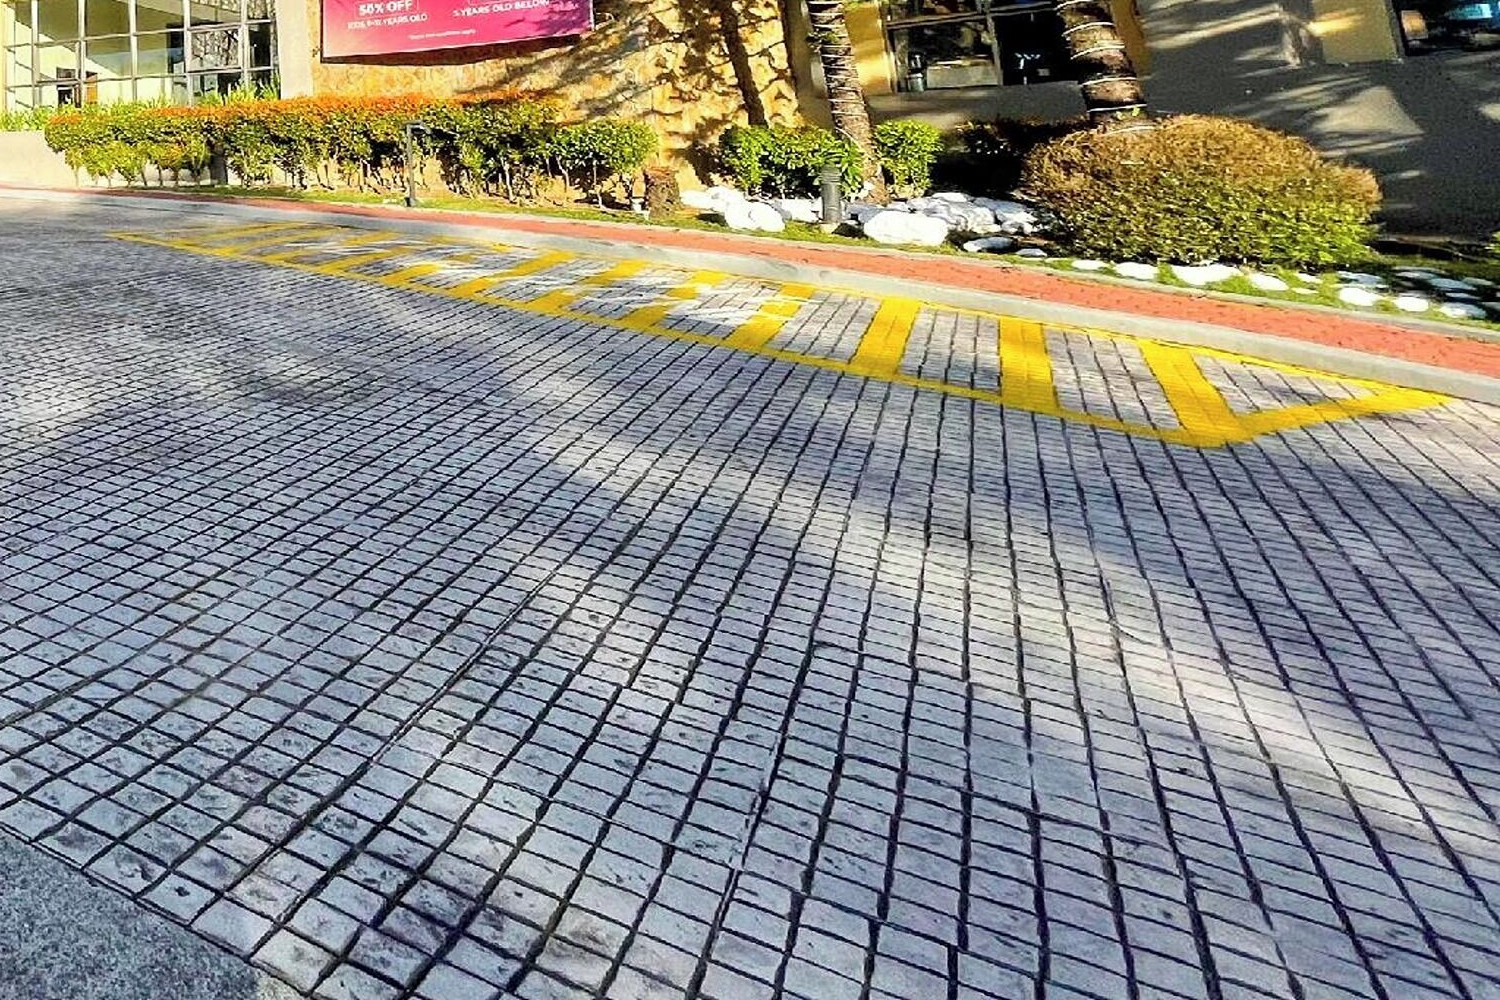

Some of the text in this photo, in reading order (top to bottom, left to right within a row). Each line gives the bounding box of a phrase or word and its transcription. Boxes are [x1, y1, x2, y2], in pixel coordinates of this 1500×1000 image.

[358, 2, 384, 16] 50%
[460, 5, 491, 16] YEARS
[492, 1, 513, 12] OLD
[409, 13, 429, 23] OLD
